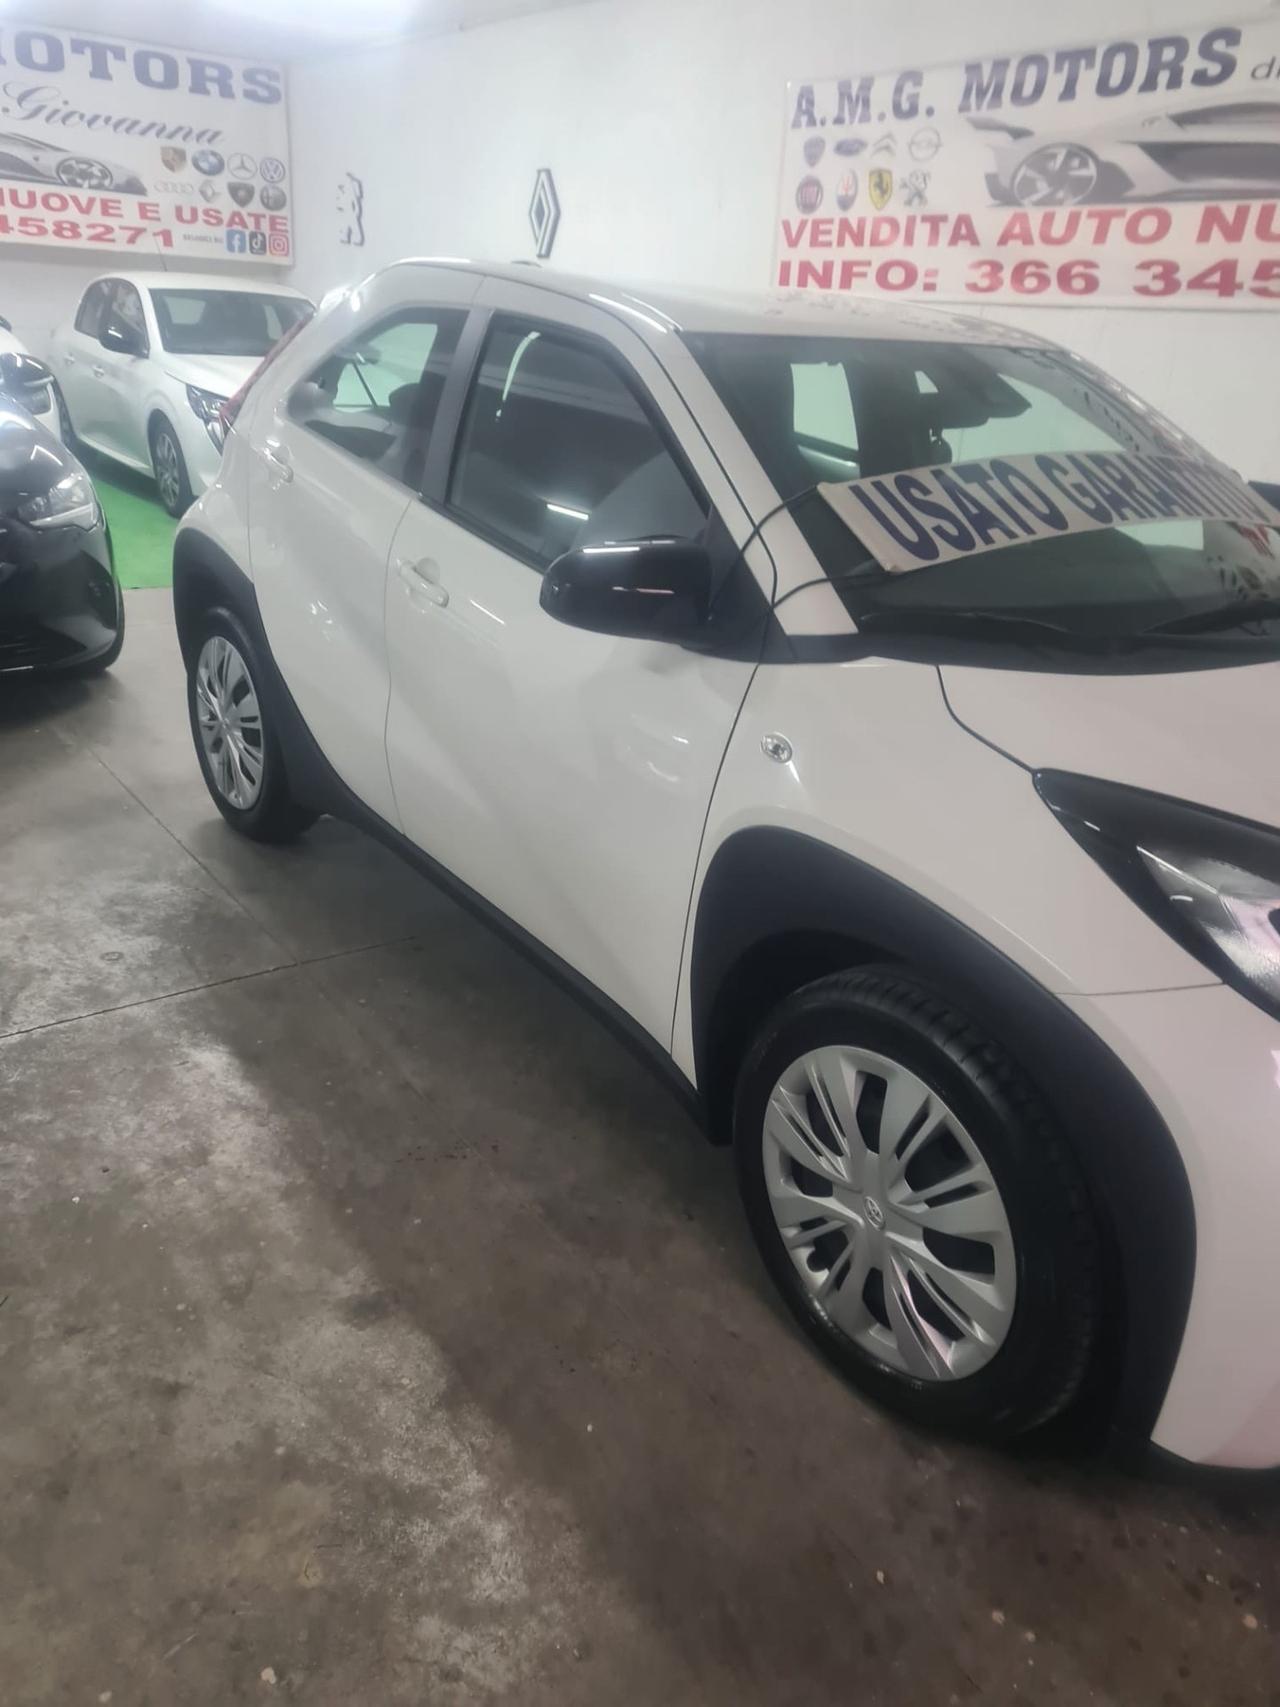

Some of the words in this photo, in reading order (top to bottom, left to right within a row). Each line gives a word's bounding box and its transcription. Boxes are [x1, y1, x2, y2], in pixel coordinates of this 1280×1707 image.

[0, 30, 282, 104] OTORS
[791, 71, 935, 128] A.M.G.
[958, 27, 1242, 113] MOTORS
[1251, 56, 1280, 80] d
[3, 81, 223, 144] Giovanna
[0, 187, 124, 218] UOVE
[137, 201, 161, 222] E
[175, 205, 289, 233] USATE
[781, 213, 980, 248] VENDITA
[997, 207, 1172, 247] AUTO
[778, 260, 938, 291] INFO:
[964, 258, 1099, 295] 366
[849, 454, 1069, 560] USATO
